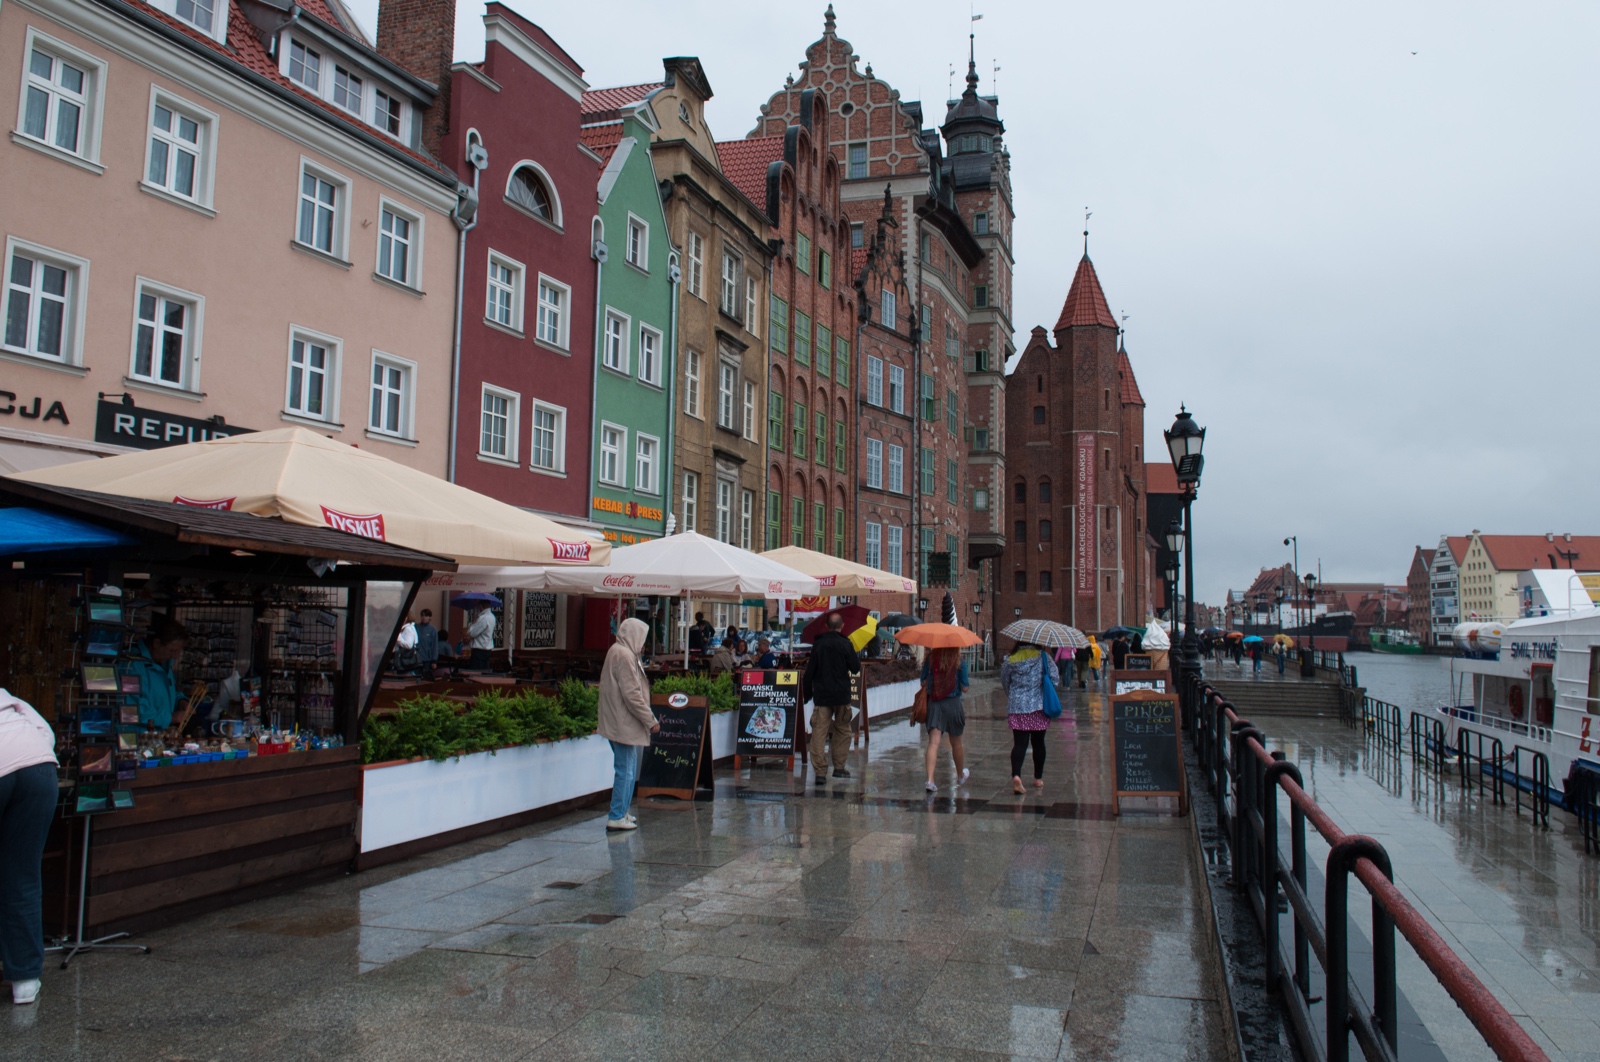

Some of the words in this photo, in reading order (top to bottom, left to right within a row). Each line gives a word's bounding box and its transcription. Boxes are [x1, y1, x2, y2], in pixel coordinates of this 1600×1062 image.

[1078, 448, 1086, 482] GDAŃSKU
[593, 497, 623, 514] KEBAB
[625, 501, 663, 521] EXPRESS
[1086, 485, 1094, 513] MUSEUM
[326, 511, 382, 540] TYSKIE
[620, 532, 636, 545] lody
[1086, 516, 1094, 573] ARCHAEOLOGICAL
[552, 541, 589, 559] TYSKIE
[742, 683, 773, 692] GDAŃSKI
[1124, 705, 1164, 718] PIWO
[1125, 720, 1167, 735] BEER
